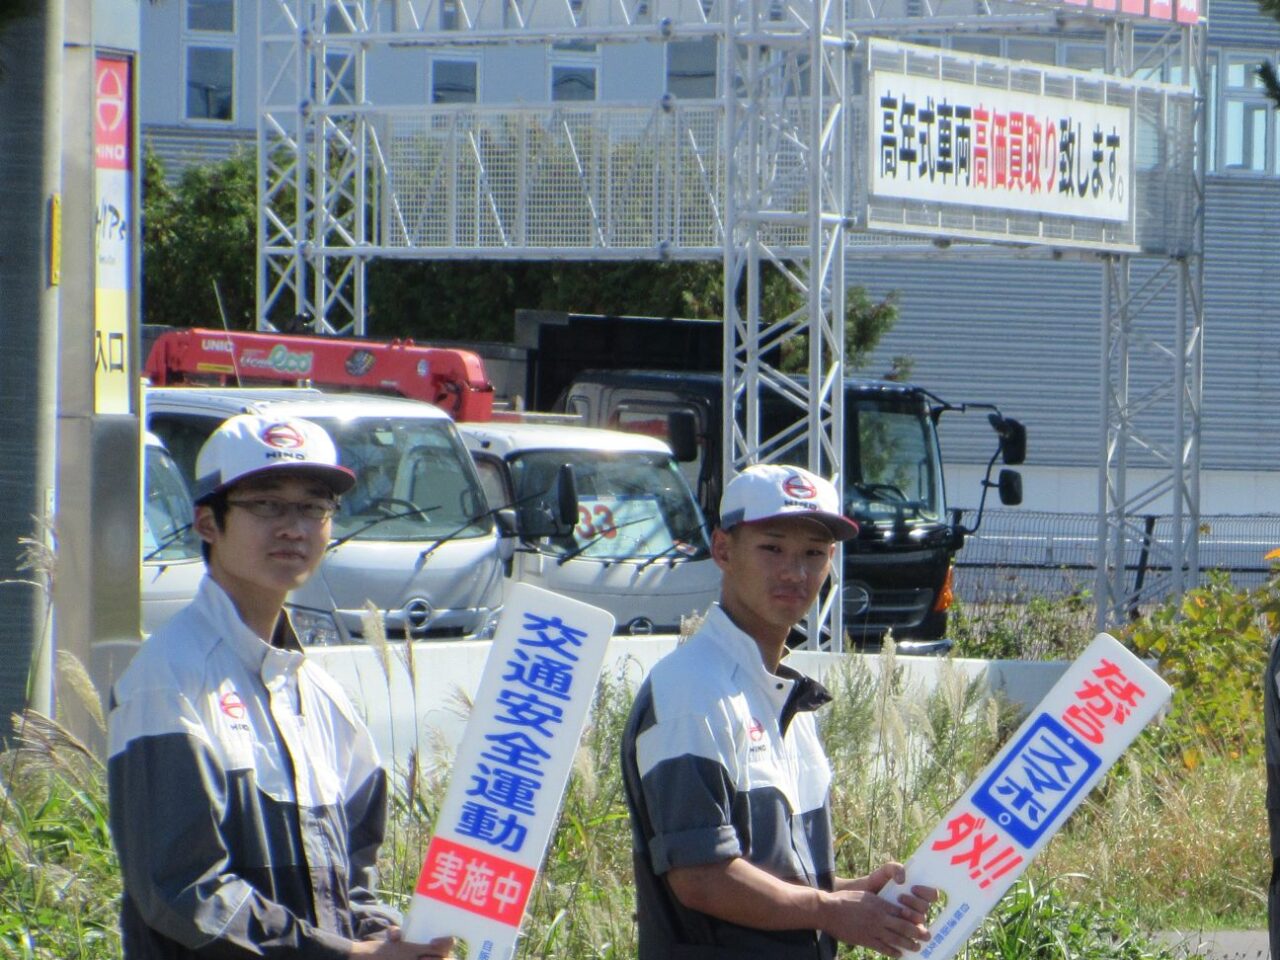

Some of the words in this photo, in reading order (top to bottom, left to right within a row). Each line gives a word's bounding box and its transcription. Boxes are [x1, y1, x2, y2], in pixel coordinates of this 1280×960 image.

[880, 89, 1123, 203] 高年式車両高価買取り致します。
[454, 612, 588, 853] 交通安全運動
[1062, 658, 1147, 745] ながら
[996, 735, 1077, 824] スマホ
[427, 850, 523, 914] 実施中
[931, 812, 1025, 890] ダメ!!
